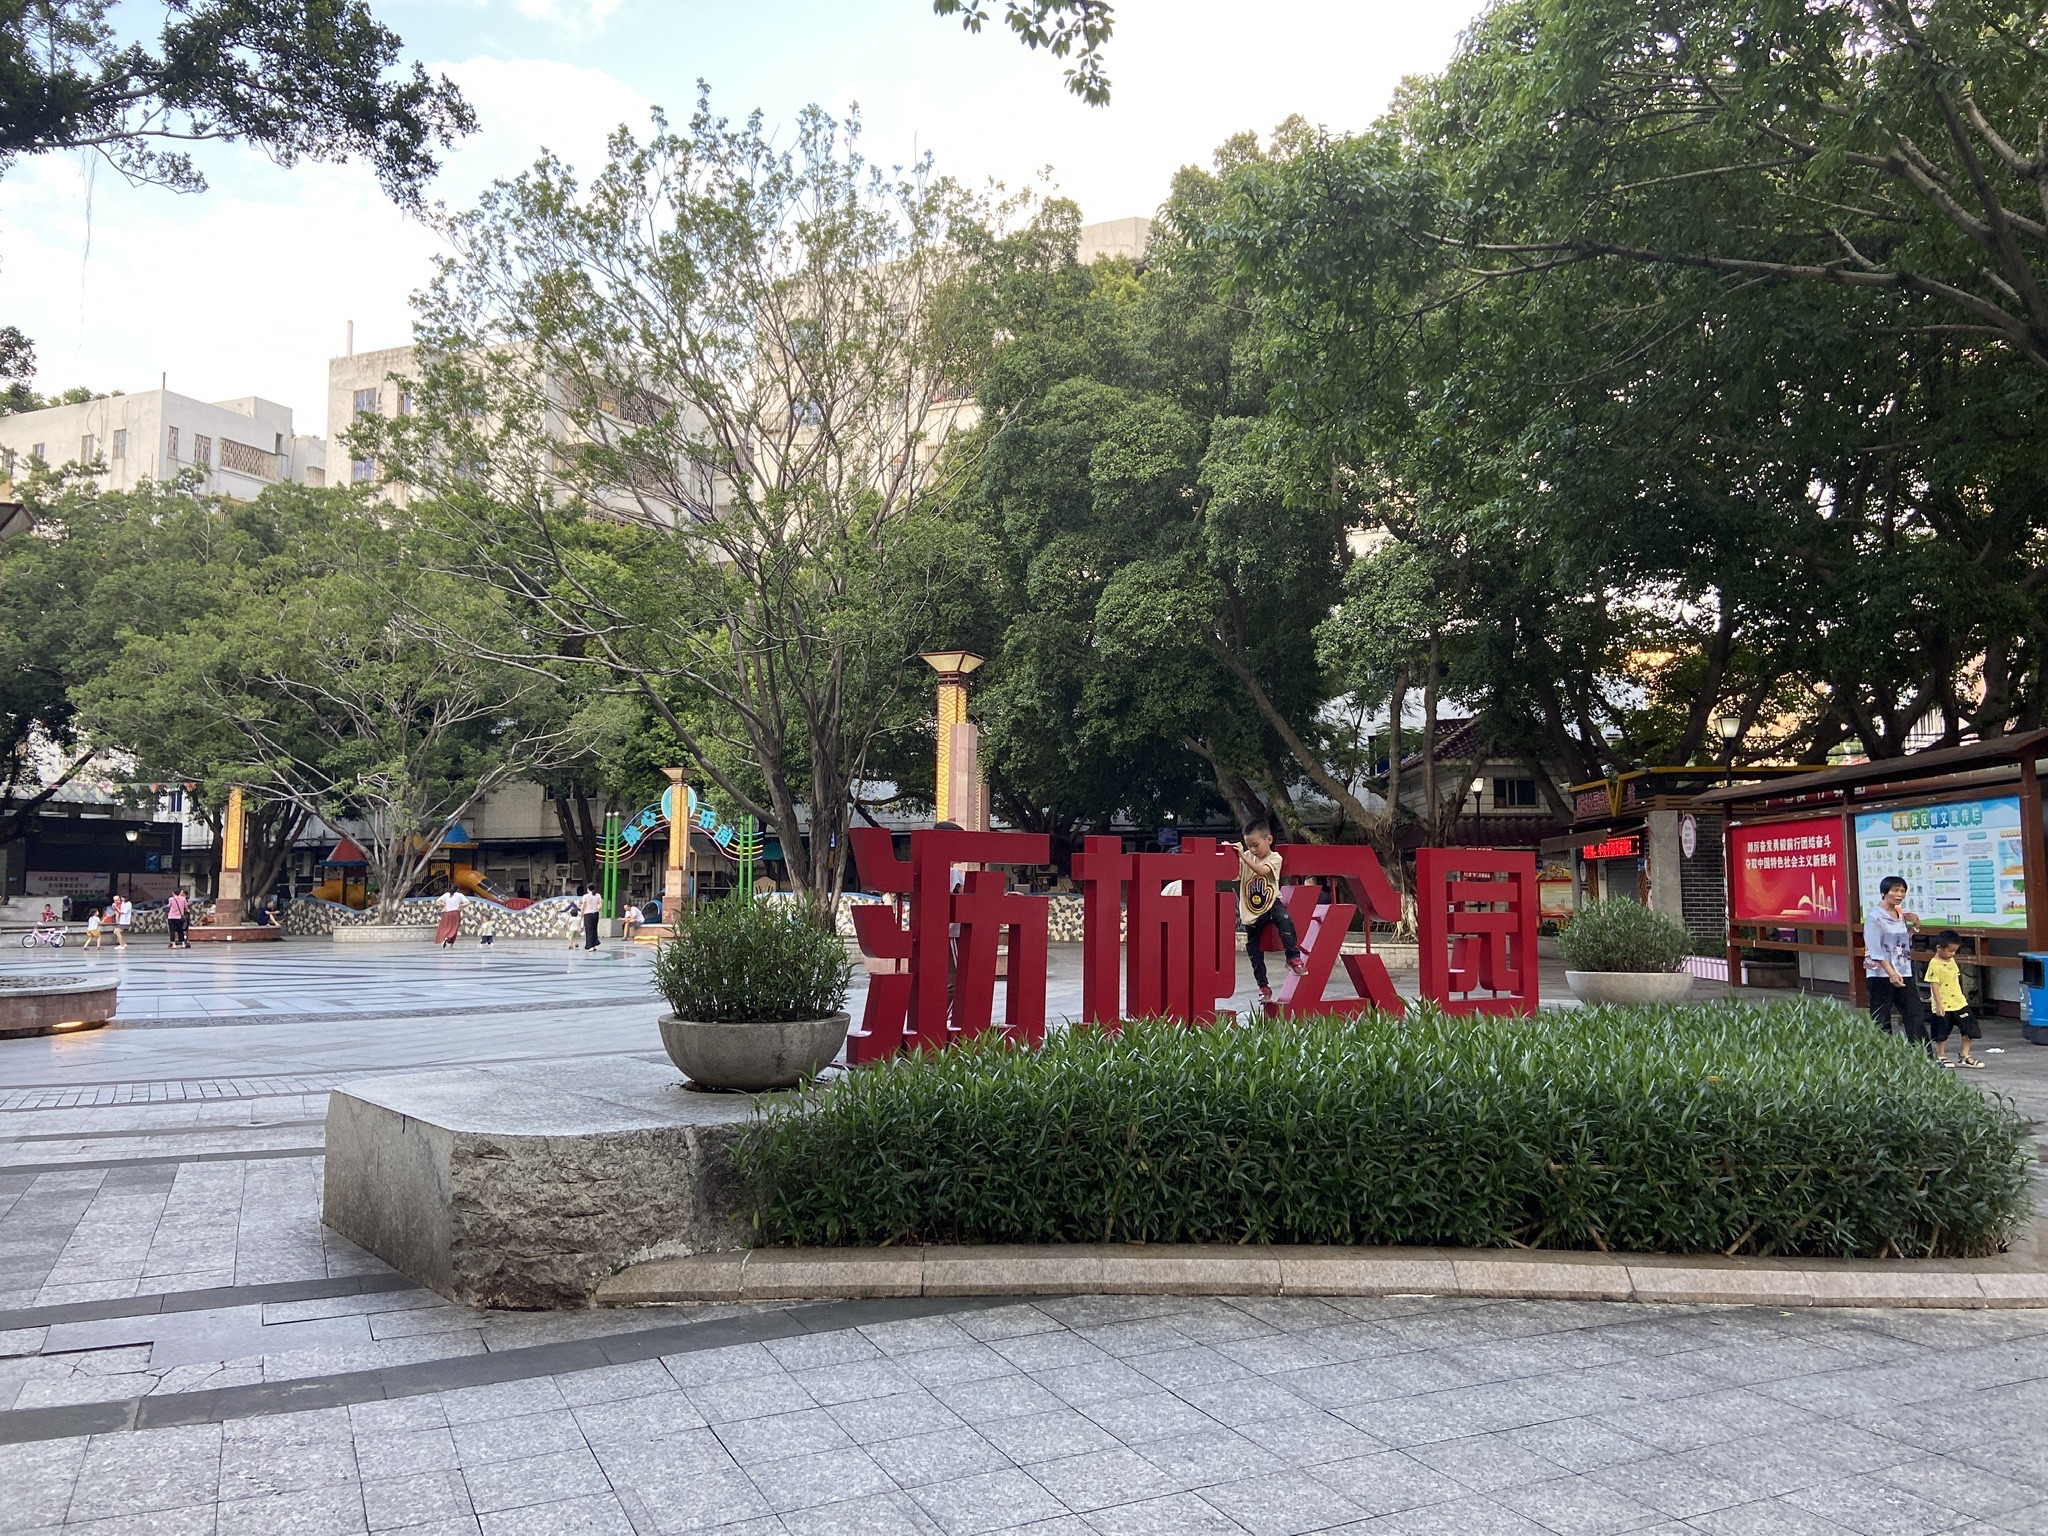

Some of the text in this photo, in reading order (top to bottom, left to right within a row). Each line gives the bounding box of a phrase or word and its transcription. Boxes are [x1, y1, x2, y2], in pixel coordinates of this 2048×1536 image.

[1745, 853, 1836, 870] 夺取中国特色社会主义新胜利
